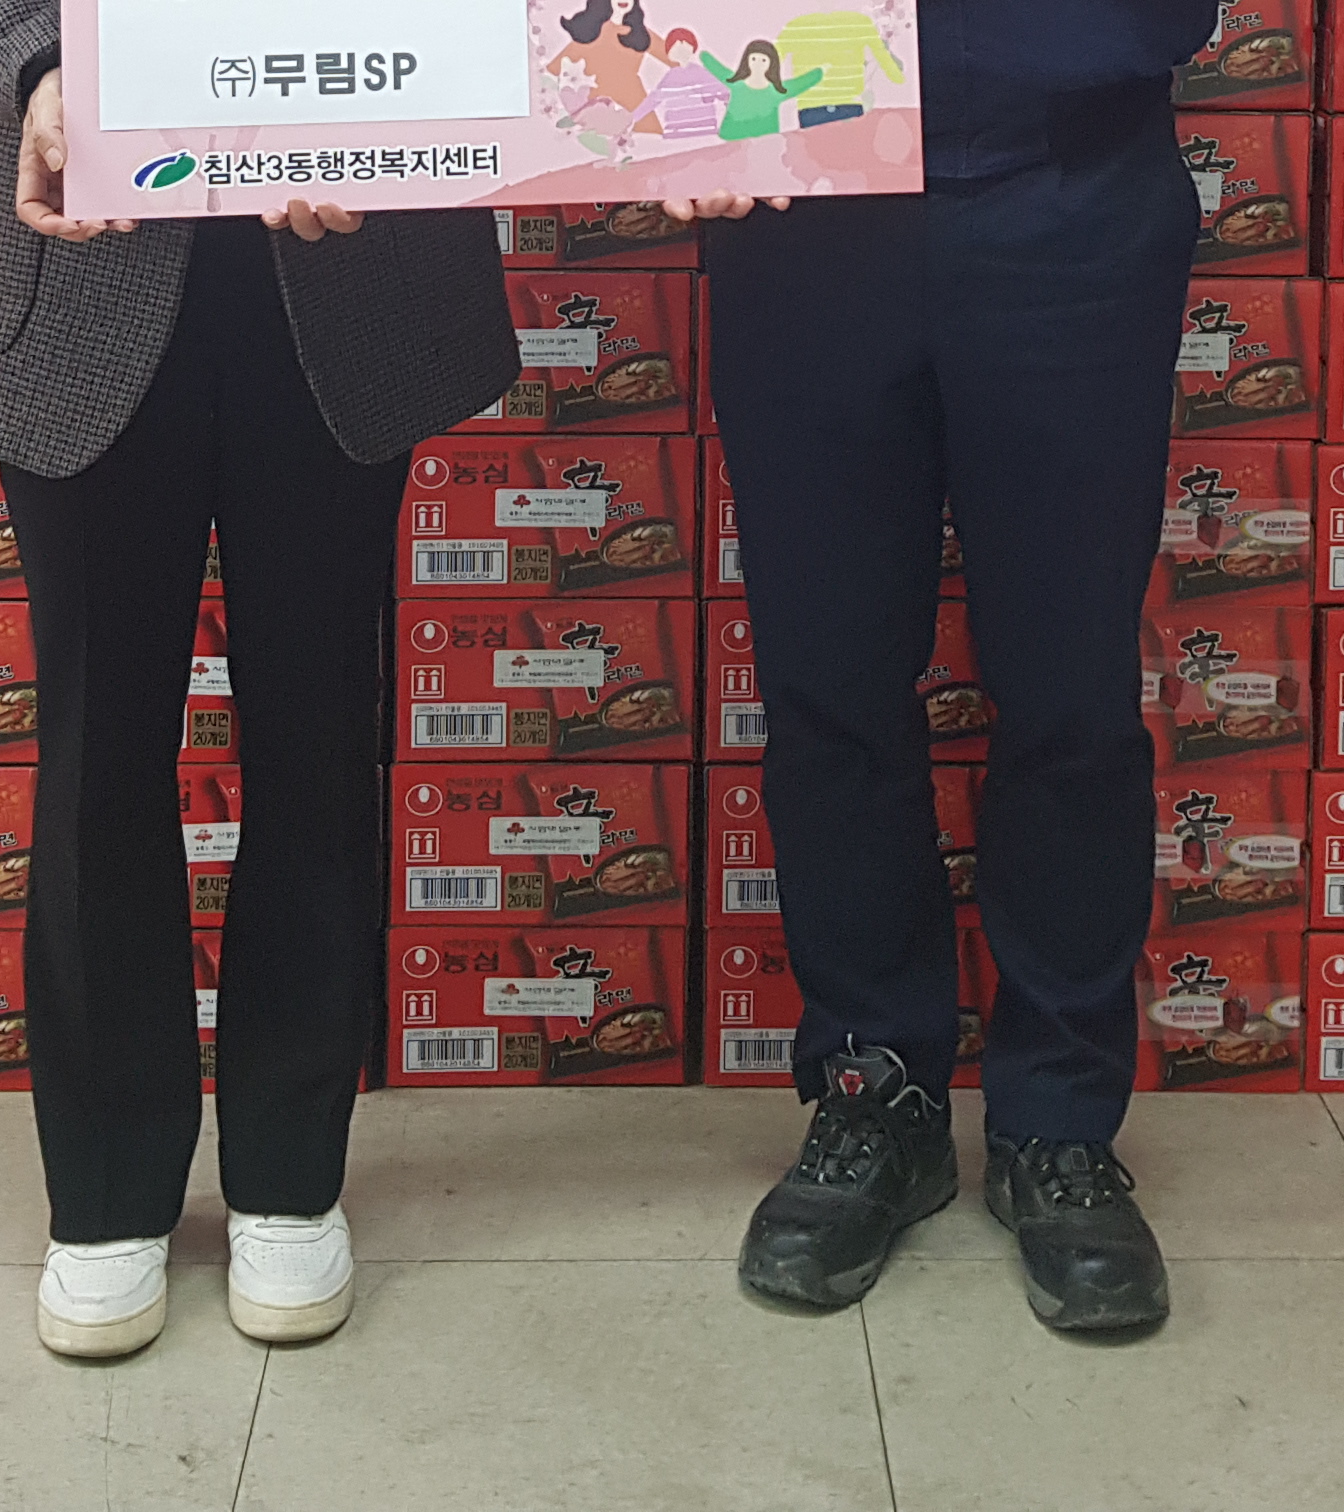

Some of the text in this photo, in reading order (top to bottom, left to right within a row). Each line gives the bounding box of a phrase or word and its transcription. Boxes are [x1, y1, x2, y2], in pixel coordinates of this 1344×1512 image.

[204, 143, 499, 187] 침산3동행정복지센터
[453, 462, 509, 484] 농심
[446, 789, 503, 811] 농심
